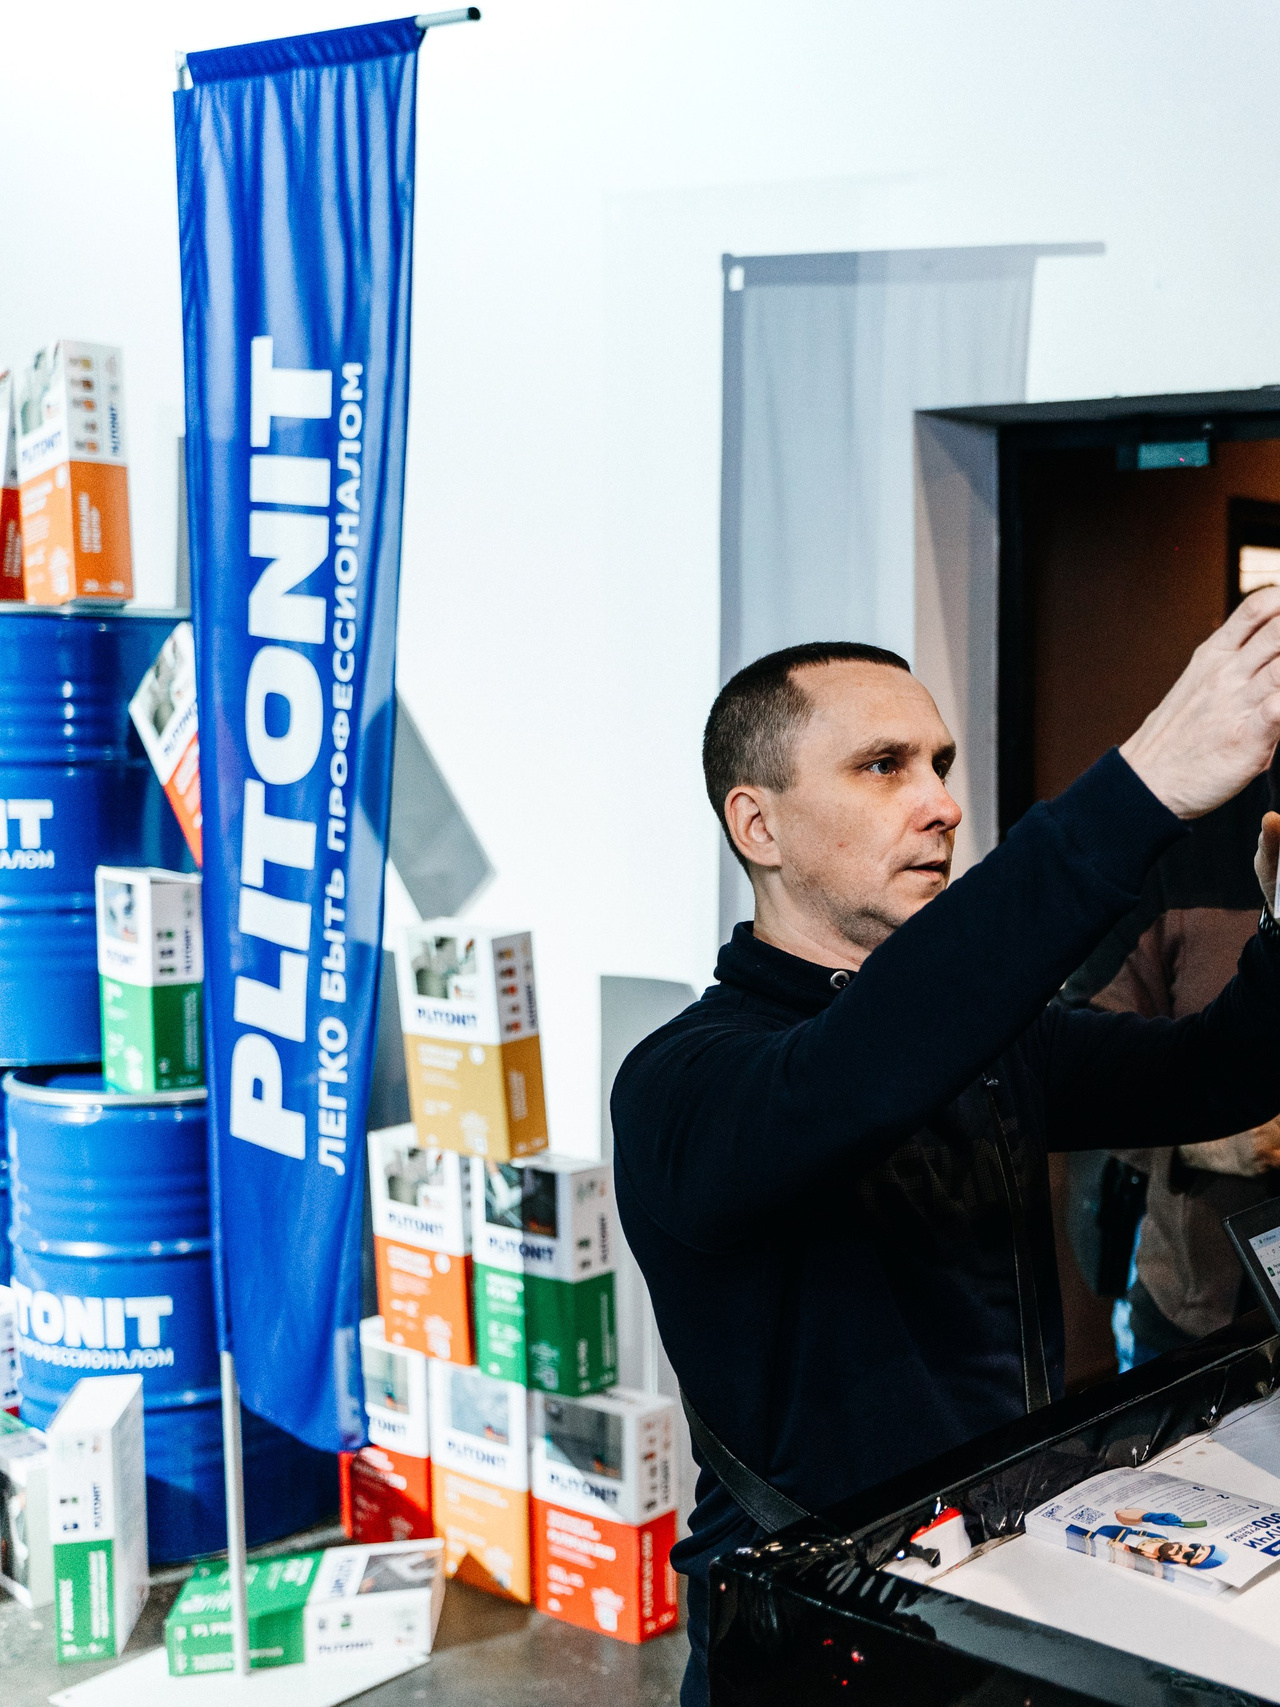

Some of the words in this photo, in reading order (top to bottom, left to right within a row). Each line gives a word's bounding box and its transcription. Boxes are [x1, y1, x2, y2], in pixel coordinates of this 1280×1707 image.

[230, 335, 332, 1160] PLITONIT
[327, 362, 363, 852] ПРОФЕССИОНАЛОМ
[318, 1016, 348, 1176] ЛЕГКО
[320, 868, 346, 1002] БЫТЬ
